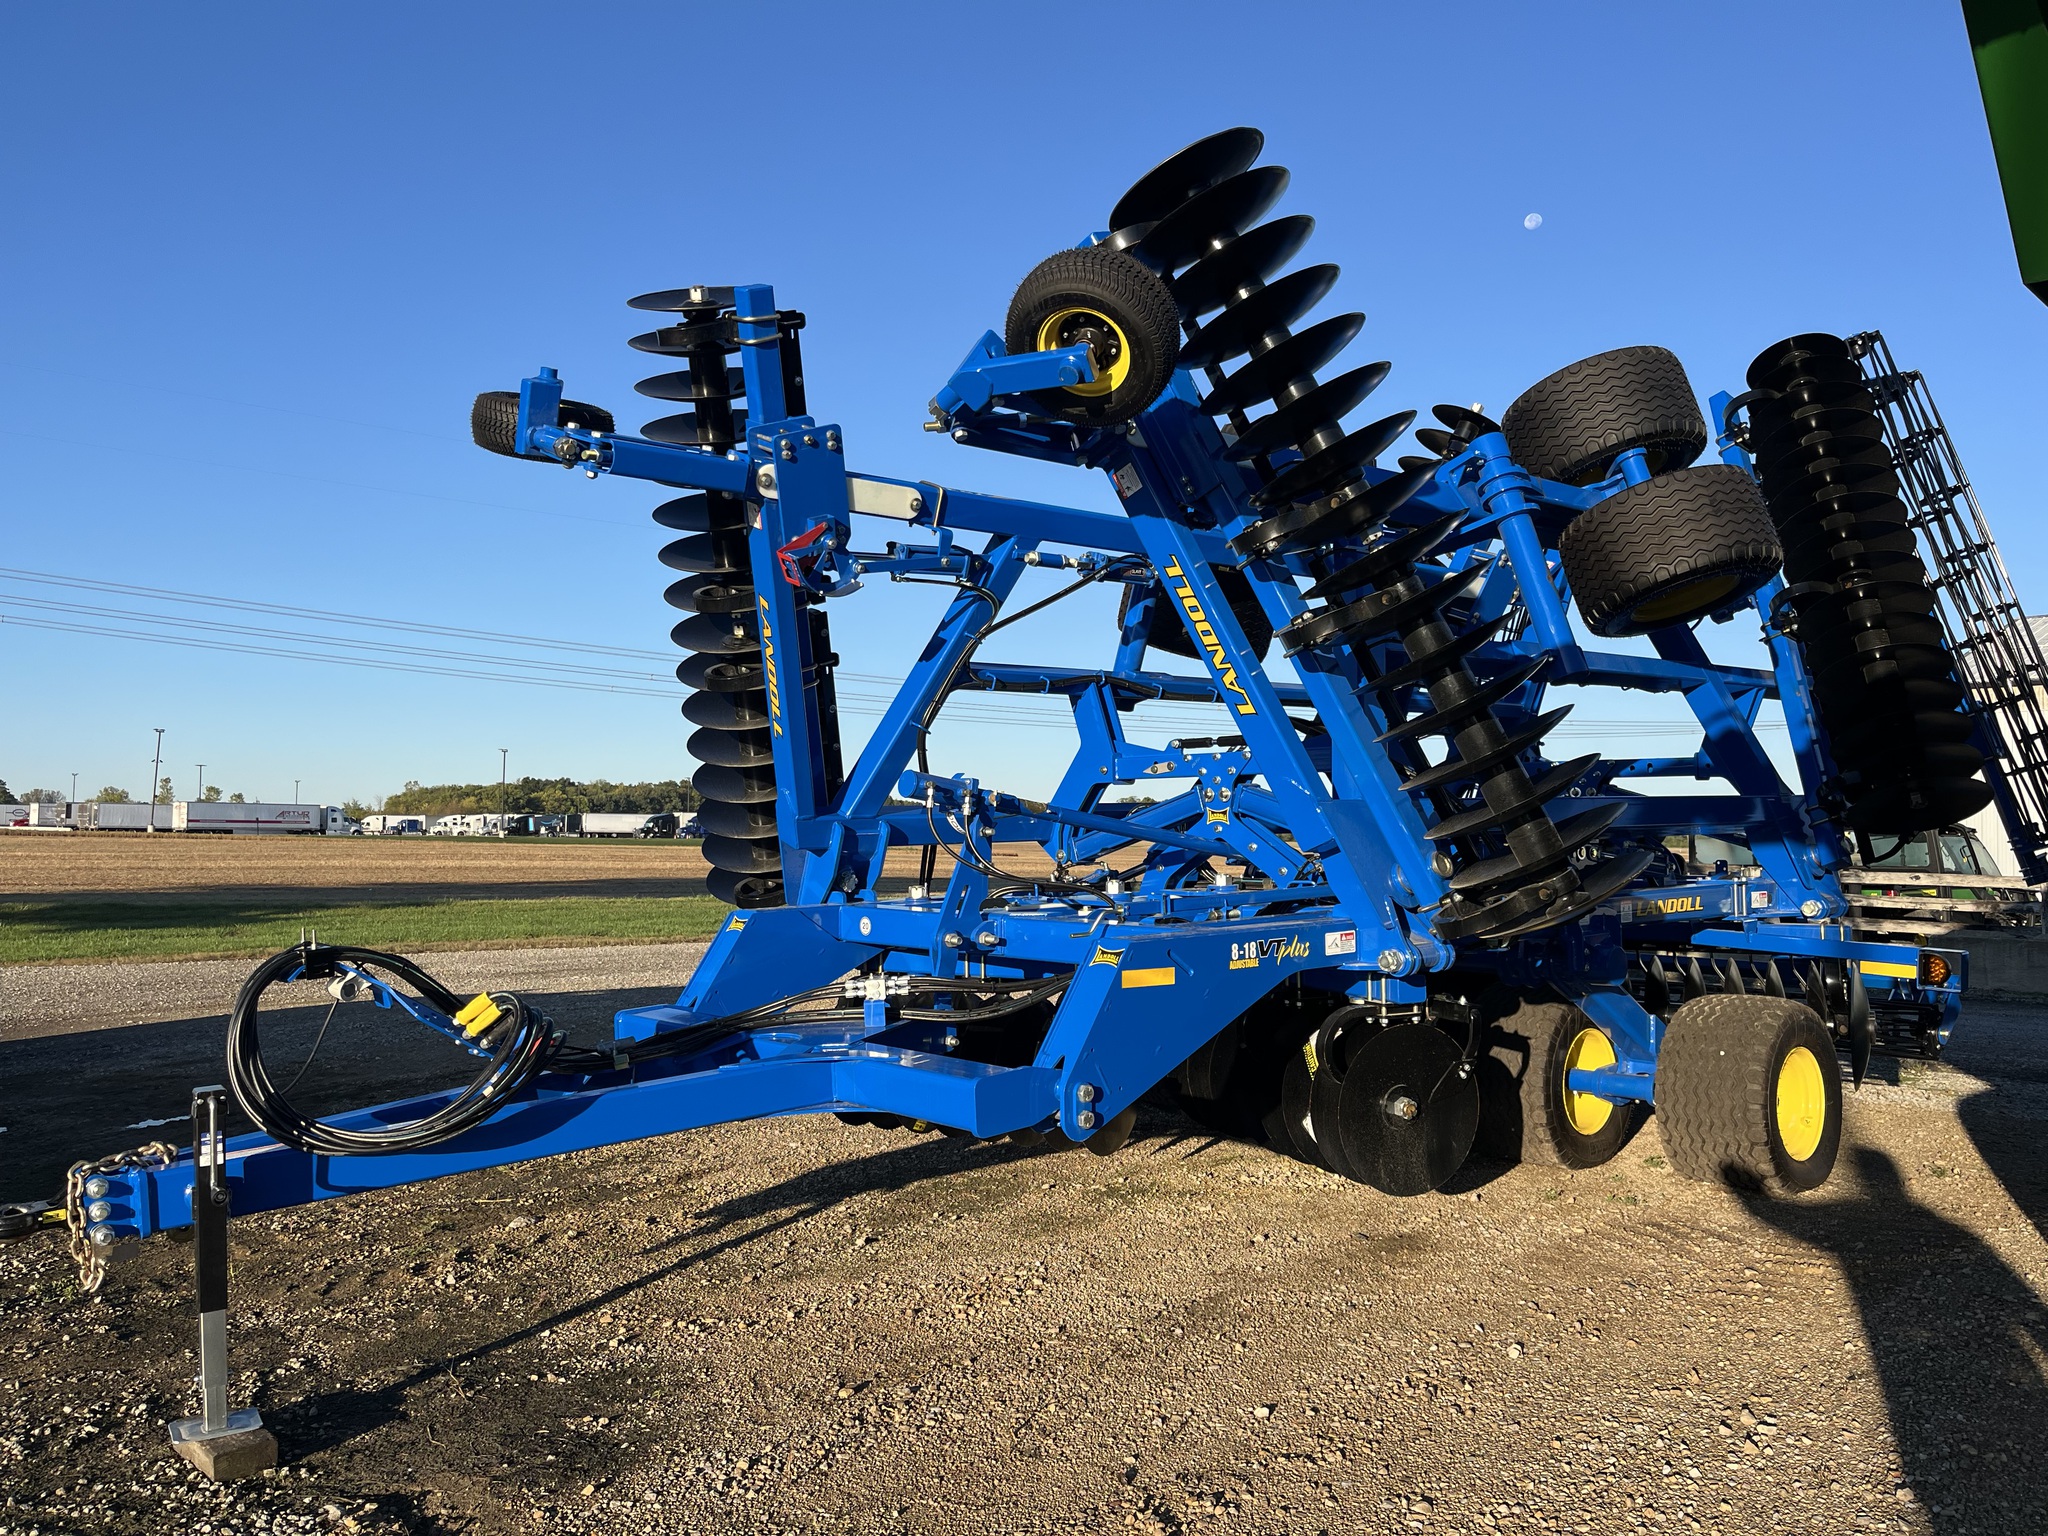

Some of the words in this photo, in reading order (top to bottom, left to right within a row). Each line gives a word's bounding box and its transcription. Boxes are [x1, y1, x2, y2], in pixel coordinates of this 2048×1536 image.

[1163, 553, 1258, 716] LANDOLL
[758, 593, 783, 738] LANDOLL
[1636, 895, 1704, 917] LANDOLL
[1095, 949, 1119, 964] LANDOLL
[1231, 941, 1257, 960] 8-18
[1229, 958, 1259, 970] ADJUSTABLE
